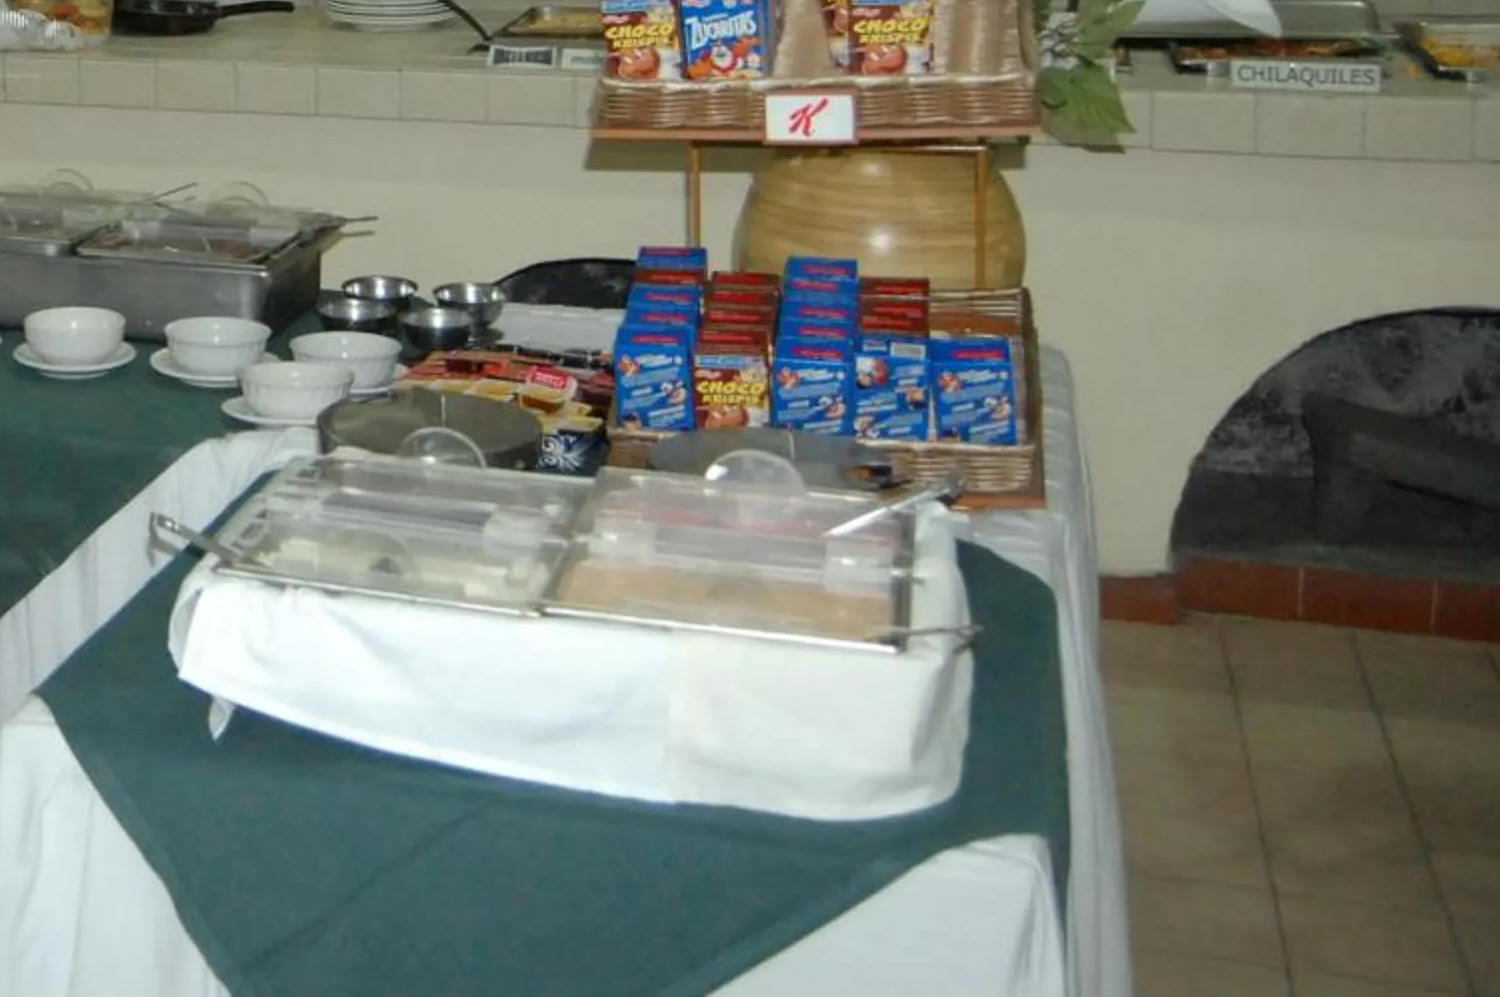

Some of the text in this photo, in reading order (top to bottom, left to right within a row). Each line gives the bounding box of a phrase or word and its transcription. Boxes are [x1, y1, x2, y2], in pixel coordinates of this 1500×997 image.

[605, 23, 673, 40] CHOCO
[853, 16, 929, 34] CHOCO
[1238, 63, 1376, 86] CHILAQUILES
[696, 380, 766, 395] CHOCO
